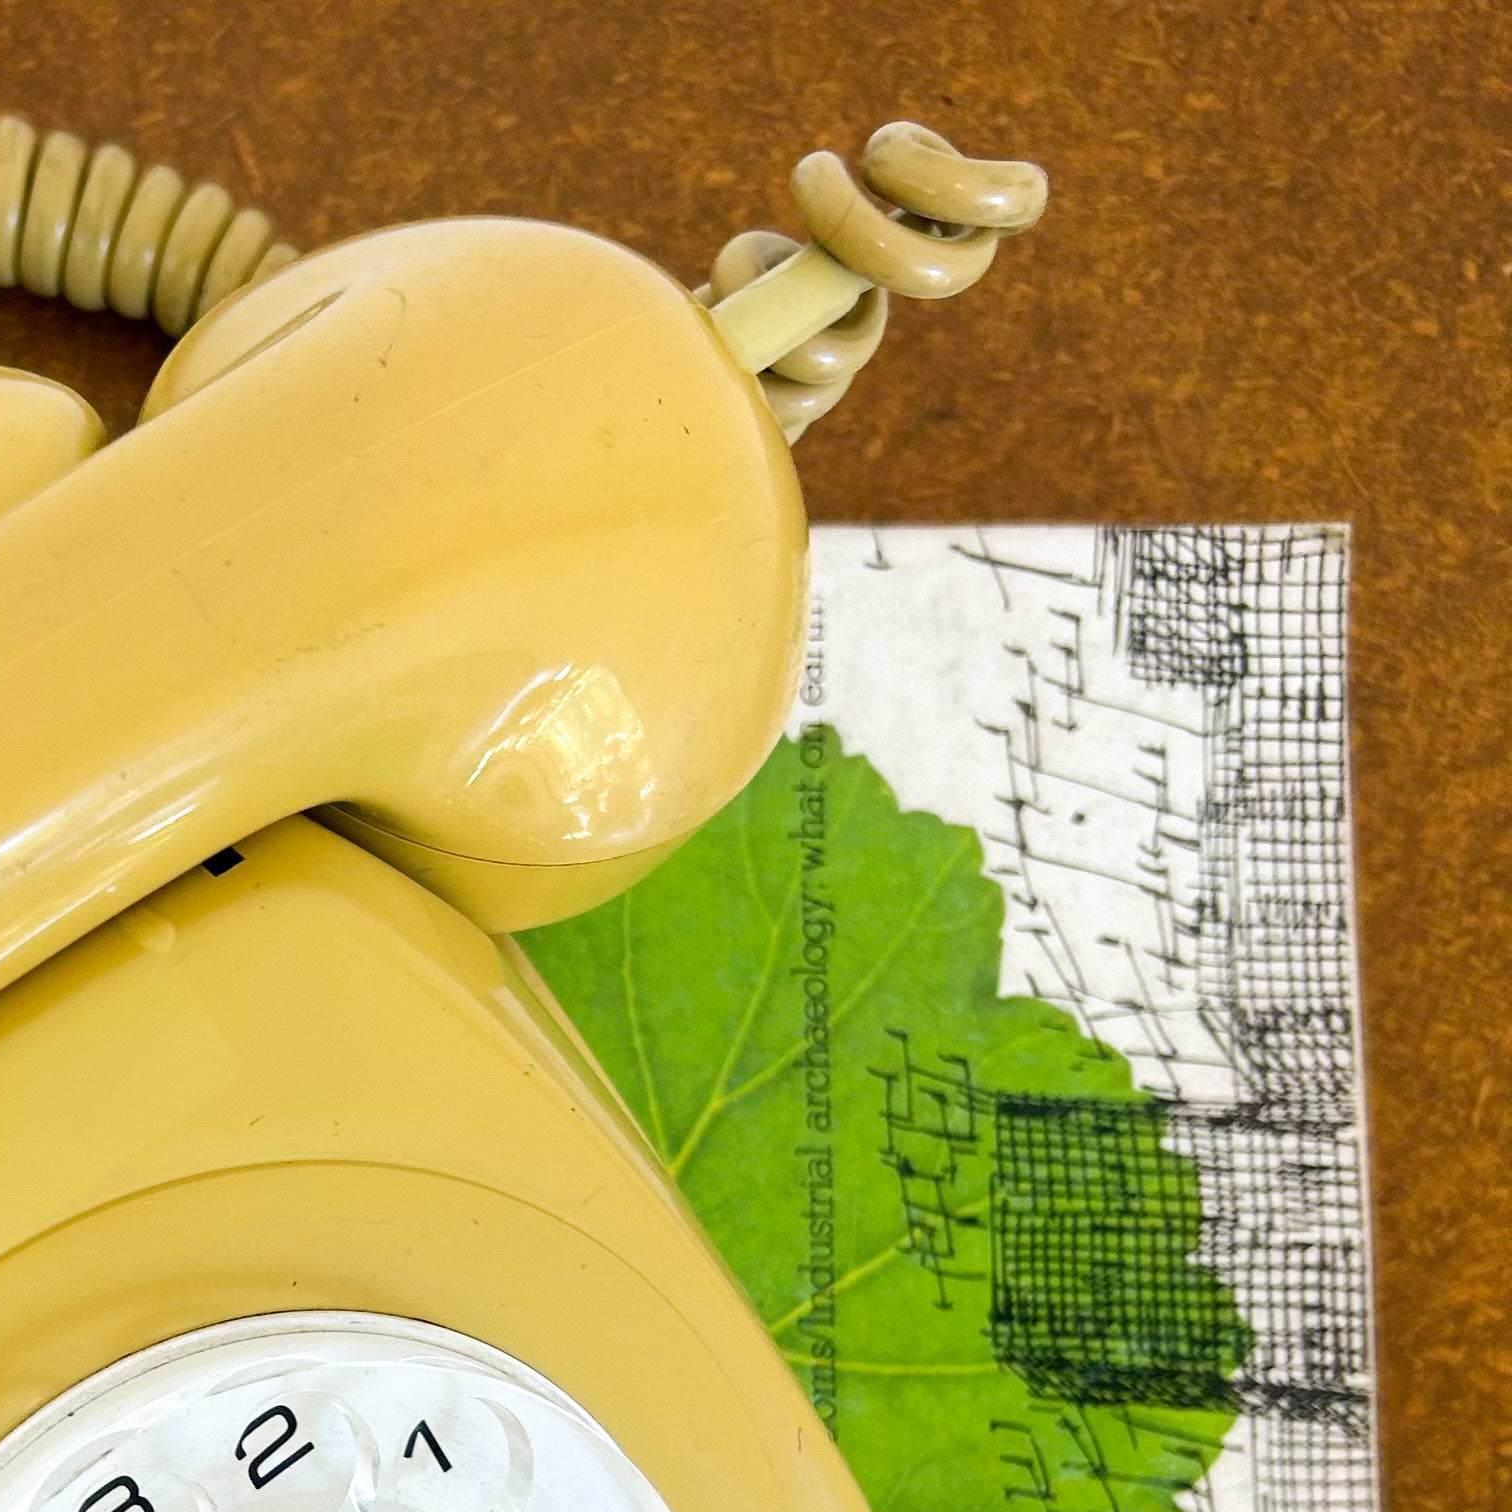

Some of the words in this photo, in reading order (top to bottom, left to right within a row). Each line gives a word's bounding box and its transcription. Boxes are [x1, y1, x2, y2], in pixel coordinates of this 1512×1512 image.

[799, 720, 826, 770] on
[787, 783, 826, 869] what
[234, 1404, 316, 1490] 2
[403, 1418, 453, 1474] 1
